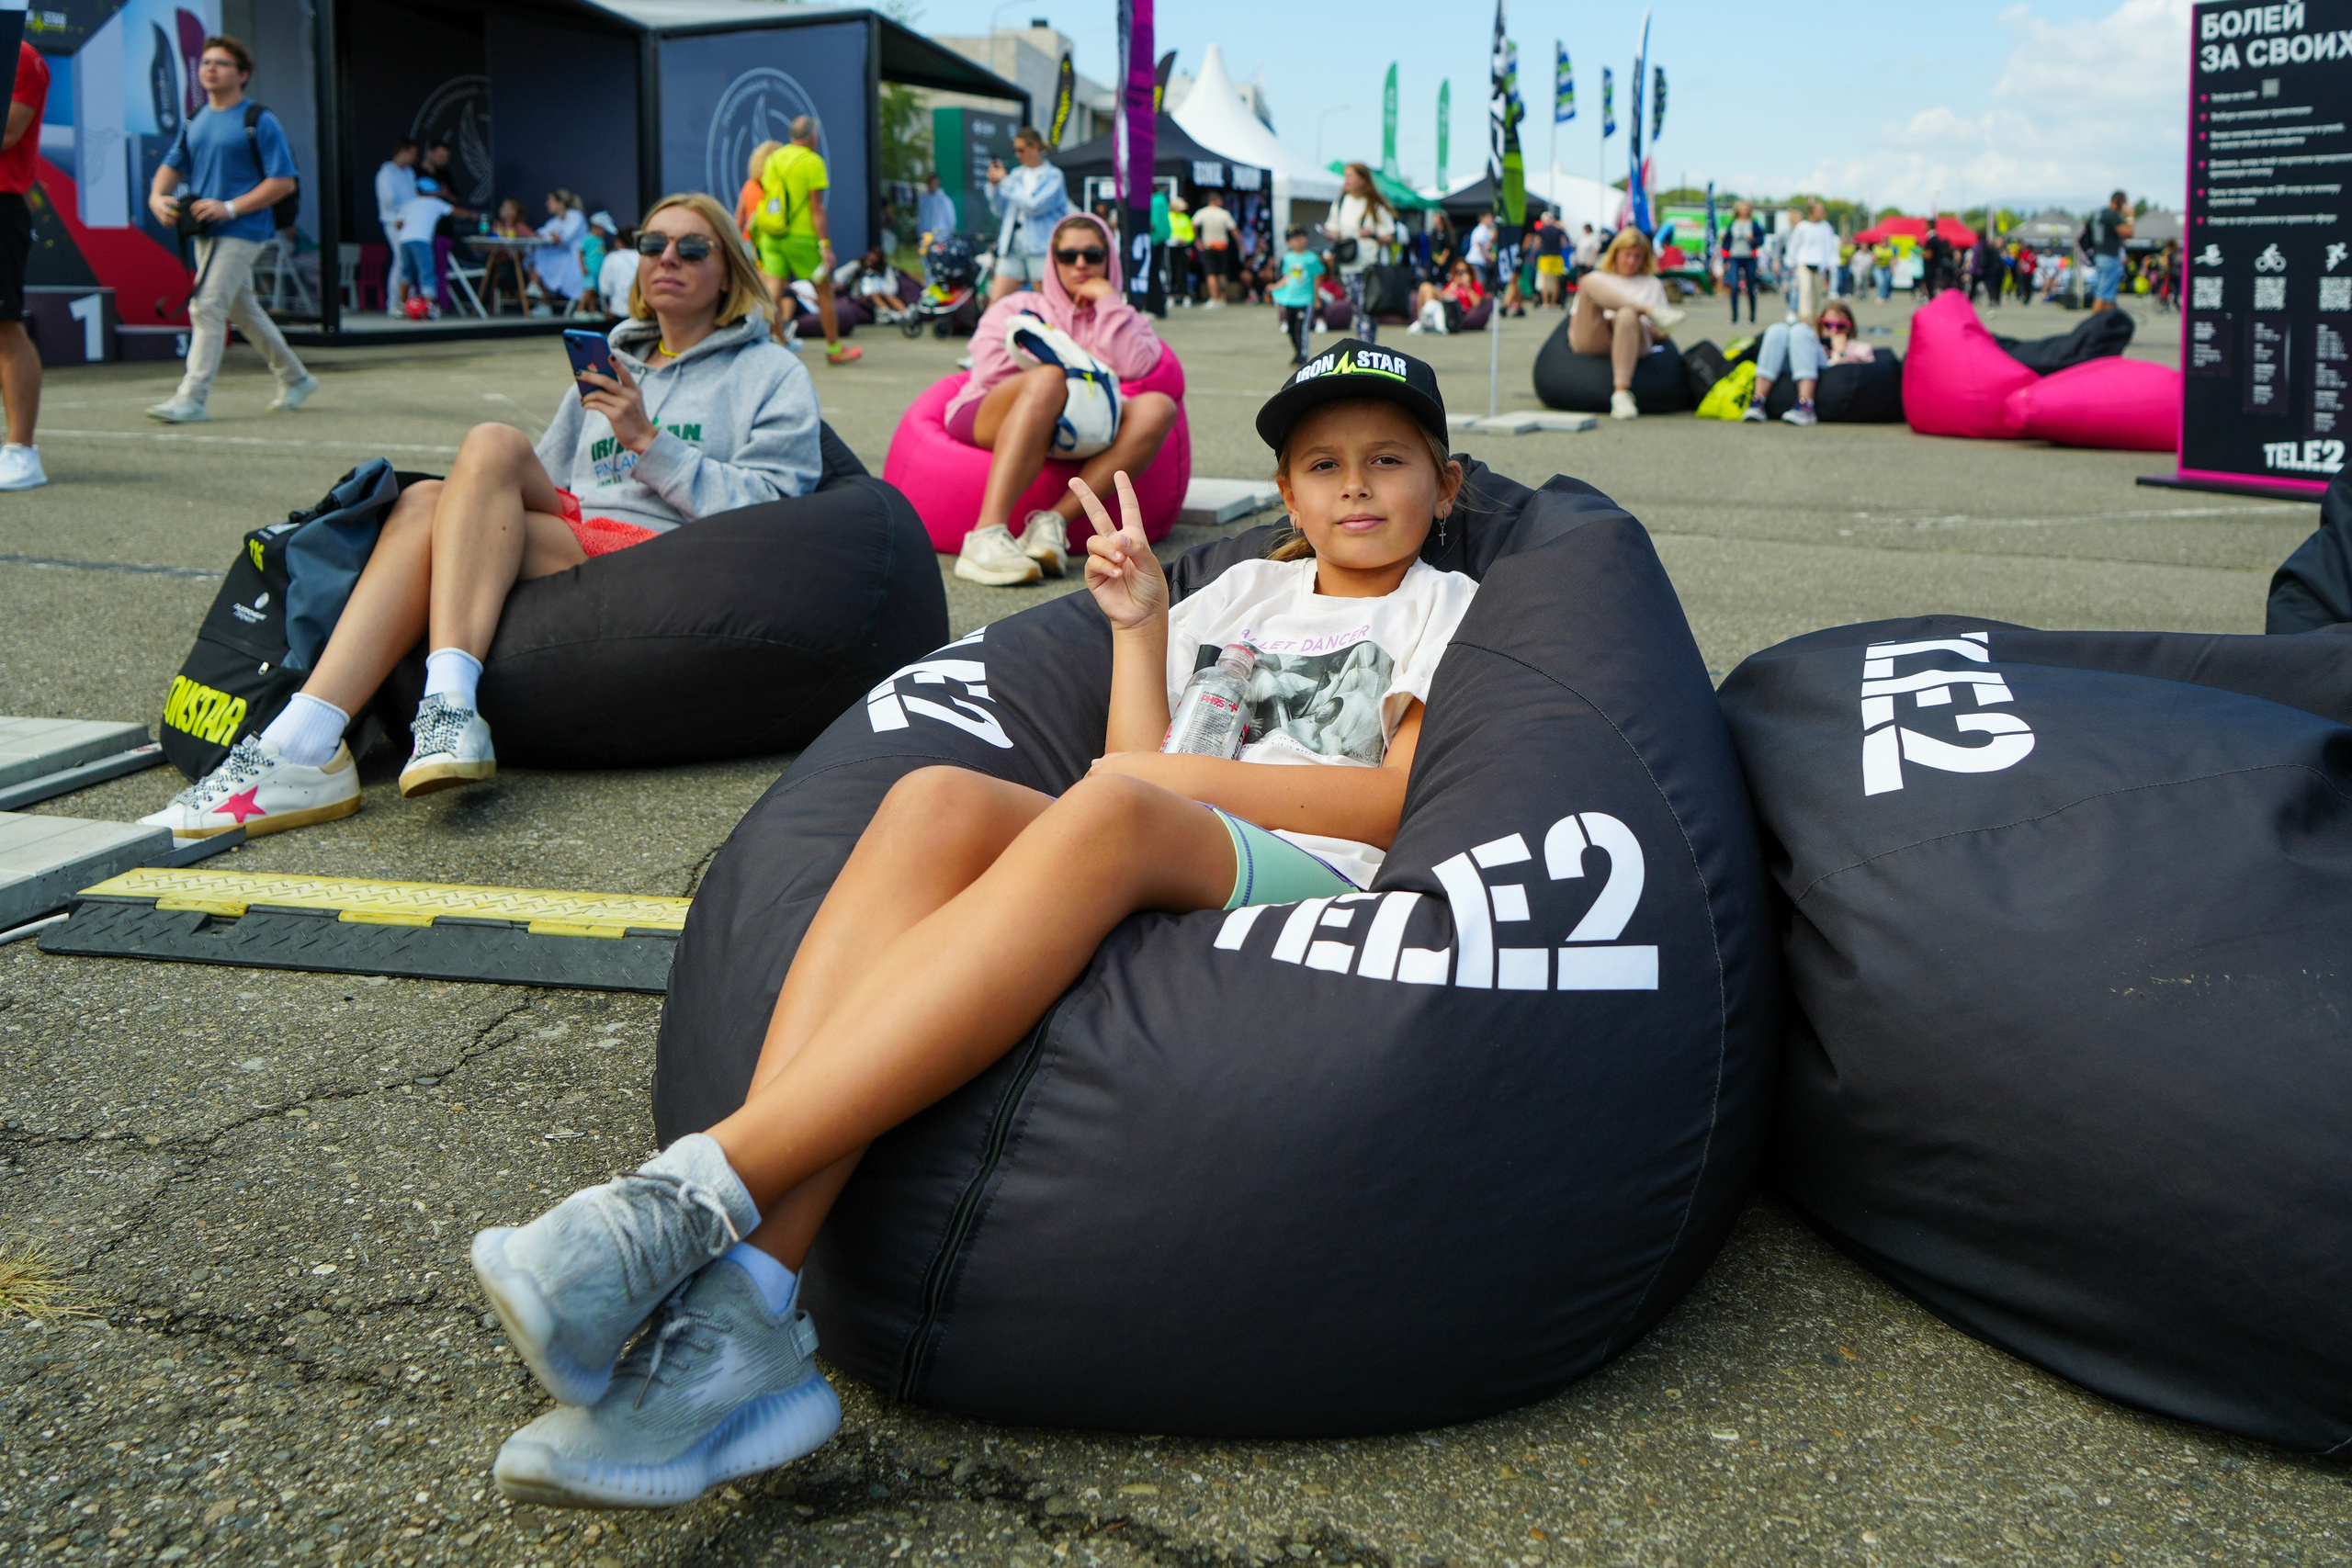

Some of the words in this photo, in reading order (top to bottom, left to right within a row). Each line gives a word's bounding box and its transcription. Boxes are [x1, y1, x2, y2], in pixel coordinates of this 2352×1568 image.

[2200, 0, 2306, 40] БОЛЕЙ
[2199, 43, 2241, 73] ЗА
[68, 293, 104, 362] 1
[1295, 353, 1335, 384] IRON
[1357, 350, 1407, 377] STAR
[2263, 440, 2346, 474] TELE2
[1240, 628, 1297, 650] ALLET
[1300, 625, 1371, 652] DANCER
[163, 675, 248, 747] ONSTAR
